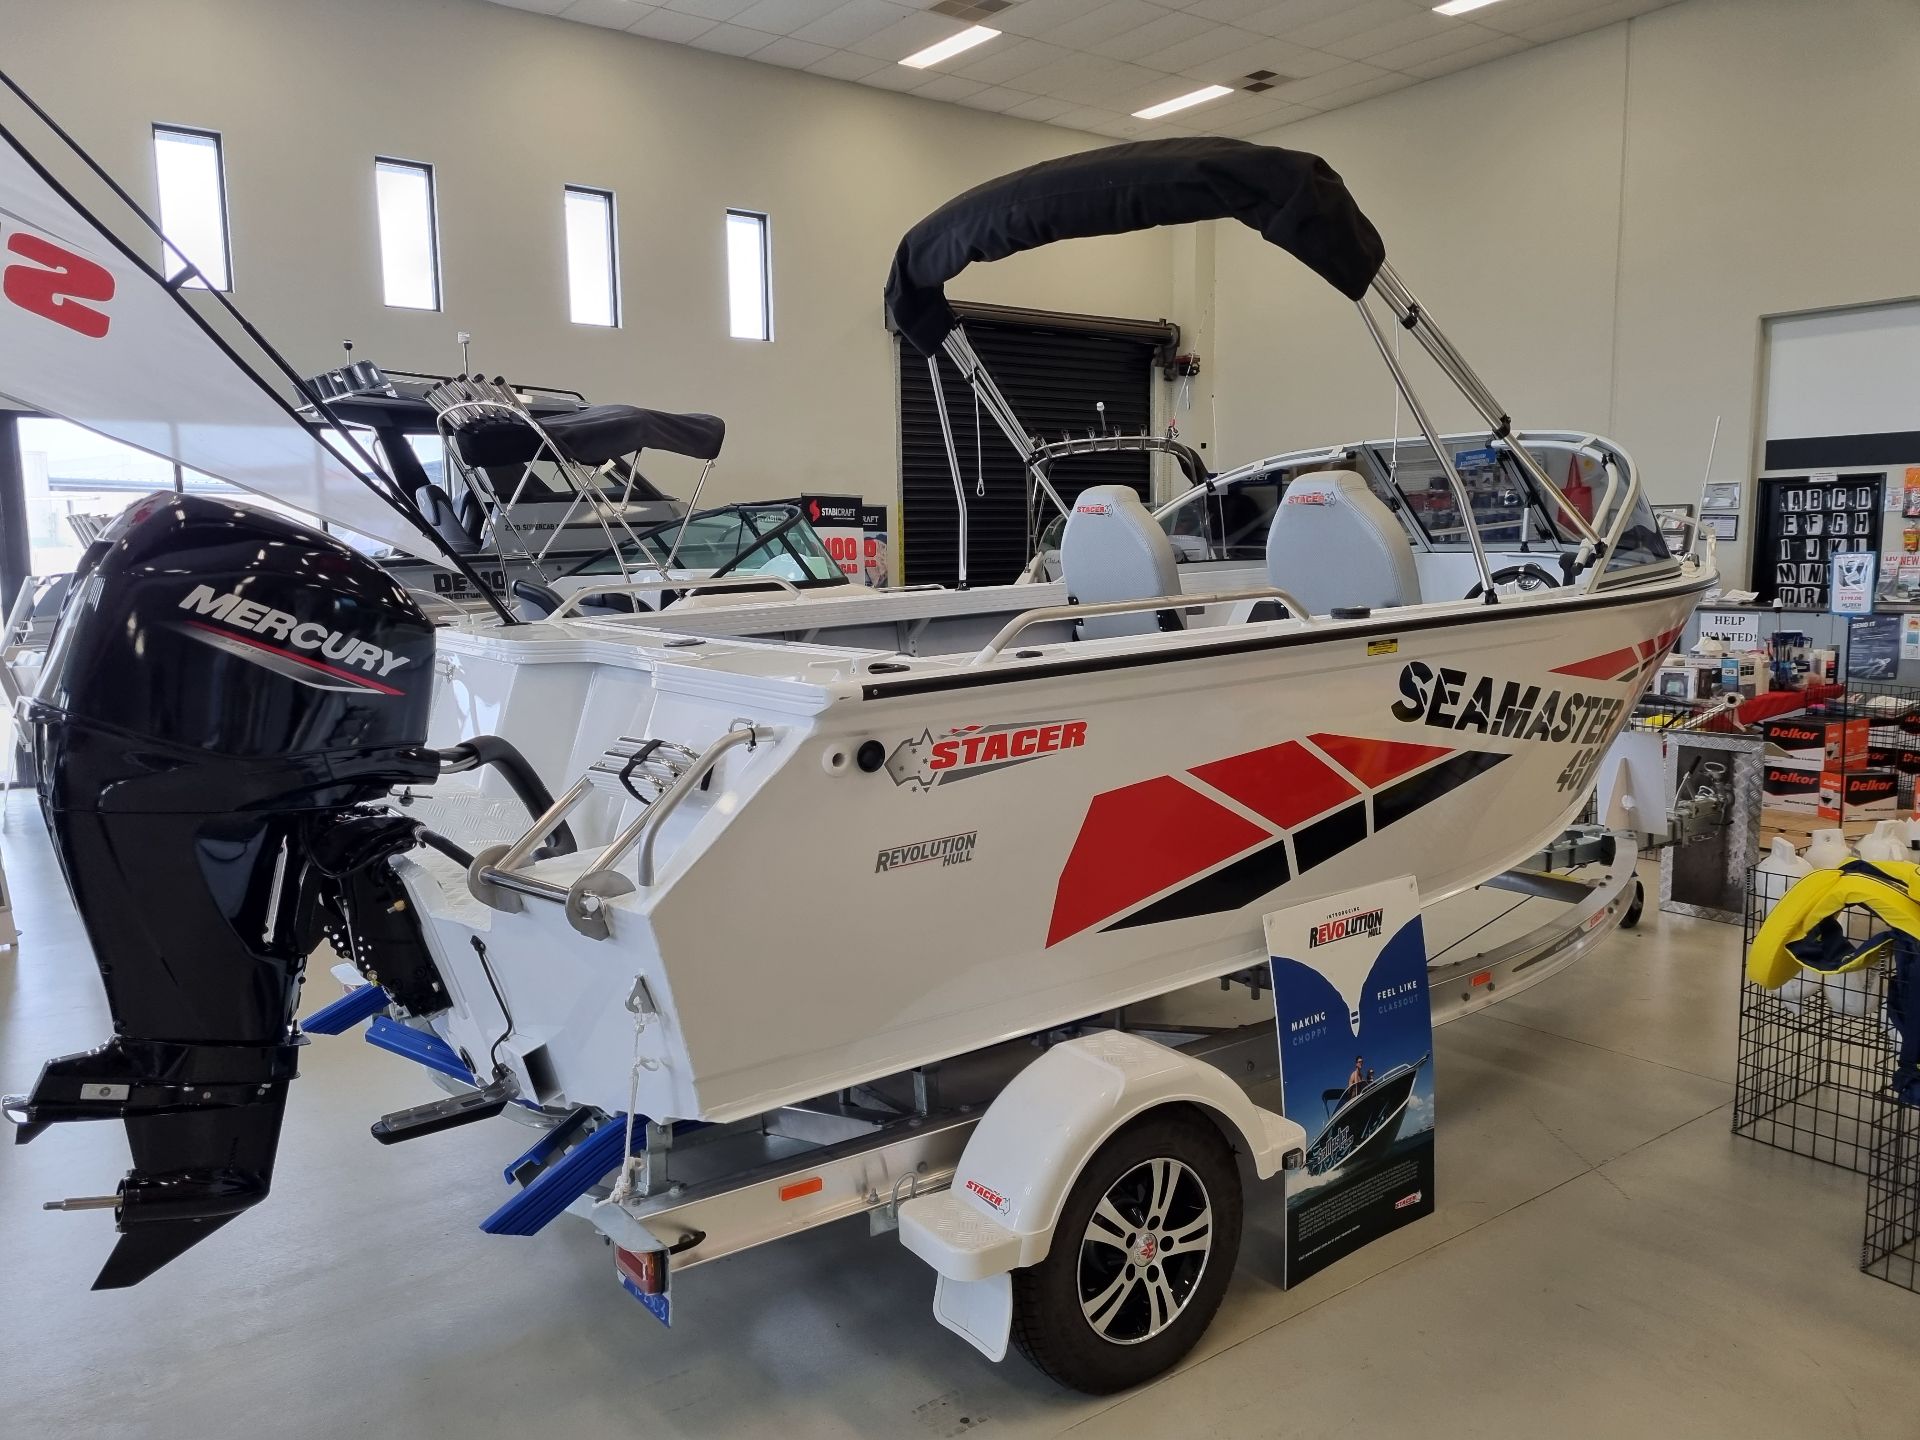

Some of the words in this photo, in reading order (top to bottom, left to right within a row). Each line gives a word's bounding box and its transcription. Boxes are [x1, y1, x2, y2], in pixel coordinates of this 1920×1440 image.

[1288, 493, 1325, 504] STACER
[1792, 491, 1801, 510] A
[1810, 490, 1821, 510] B
[1834, 489, 1846, 508] C
[1858, 489, 1869, 508] D
[821, 508, 856, 517] STABICRAFT
[1076, 504, 1105, 514] STACER
[1785, 515, 1795, 534] E
[1808, 515, 1818, 533] F
[1833, 514, 1844, 533] G
[1856, 513, 1868, 532] H
[1807, 540, 1818, 558] J
[1900, 556, 1919, 566] NEW
[1778, 564, 1795, 583] M
[178, 584, 411, 677] MERCURY
[1714, 616, 1745, 626] HELP
[1701, 631, 1758, 642] WANTED!
[1390, 661, 1624, 745] SEAMASTER
[1769, 727, 1820, 741] Delkor
[929, 721, 1088, 771] STACER
[1769, 771, 1817, 785] Delkor
[1850, 780, 1894, 792] Delkor
[874, 831, 978, 874] REVOLUTION
[942, 849, 973, 868] HULL
[1326, 906, 1360, 919] INTRODUCING
[1309, 910, 1384, 949] REVOLUTION
[1368, 926, 1382, 939] HULL
[1377, 987, 1396, 1001] FEEL
[1399, 980, 1417, 993] LIKE
[1291, 1011, 1326, 1032] MAKING
[1292, 1027, 1327, 1047] CHOPPY
[965, 1180, 1003, 1207] STACER
